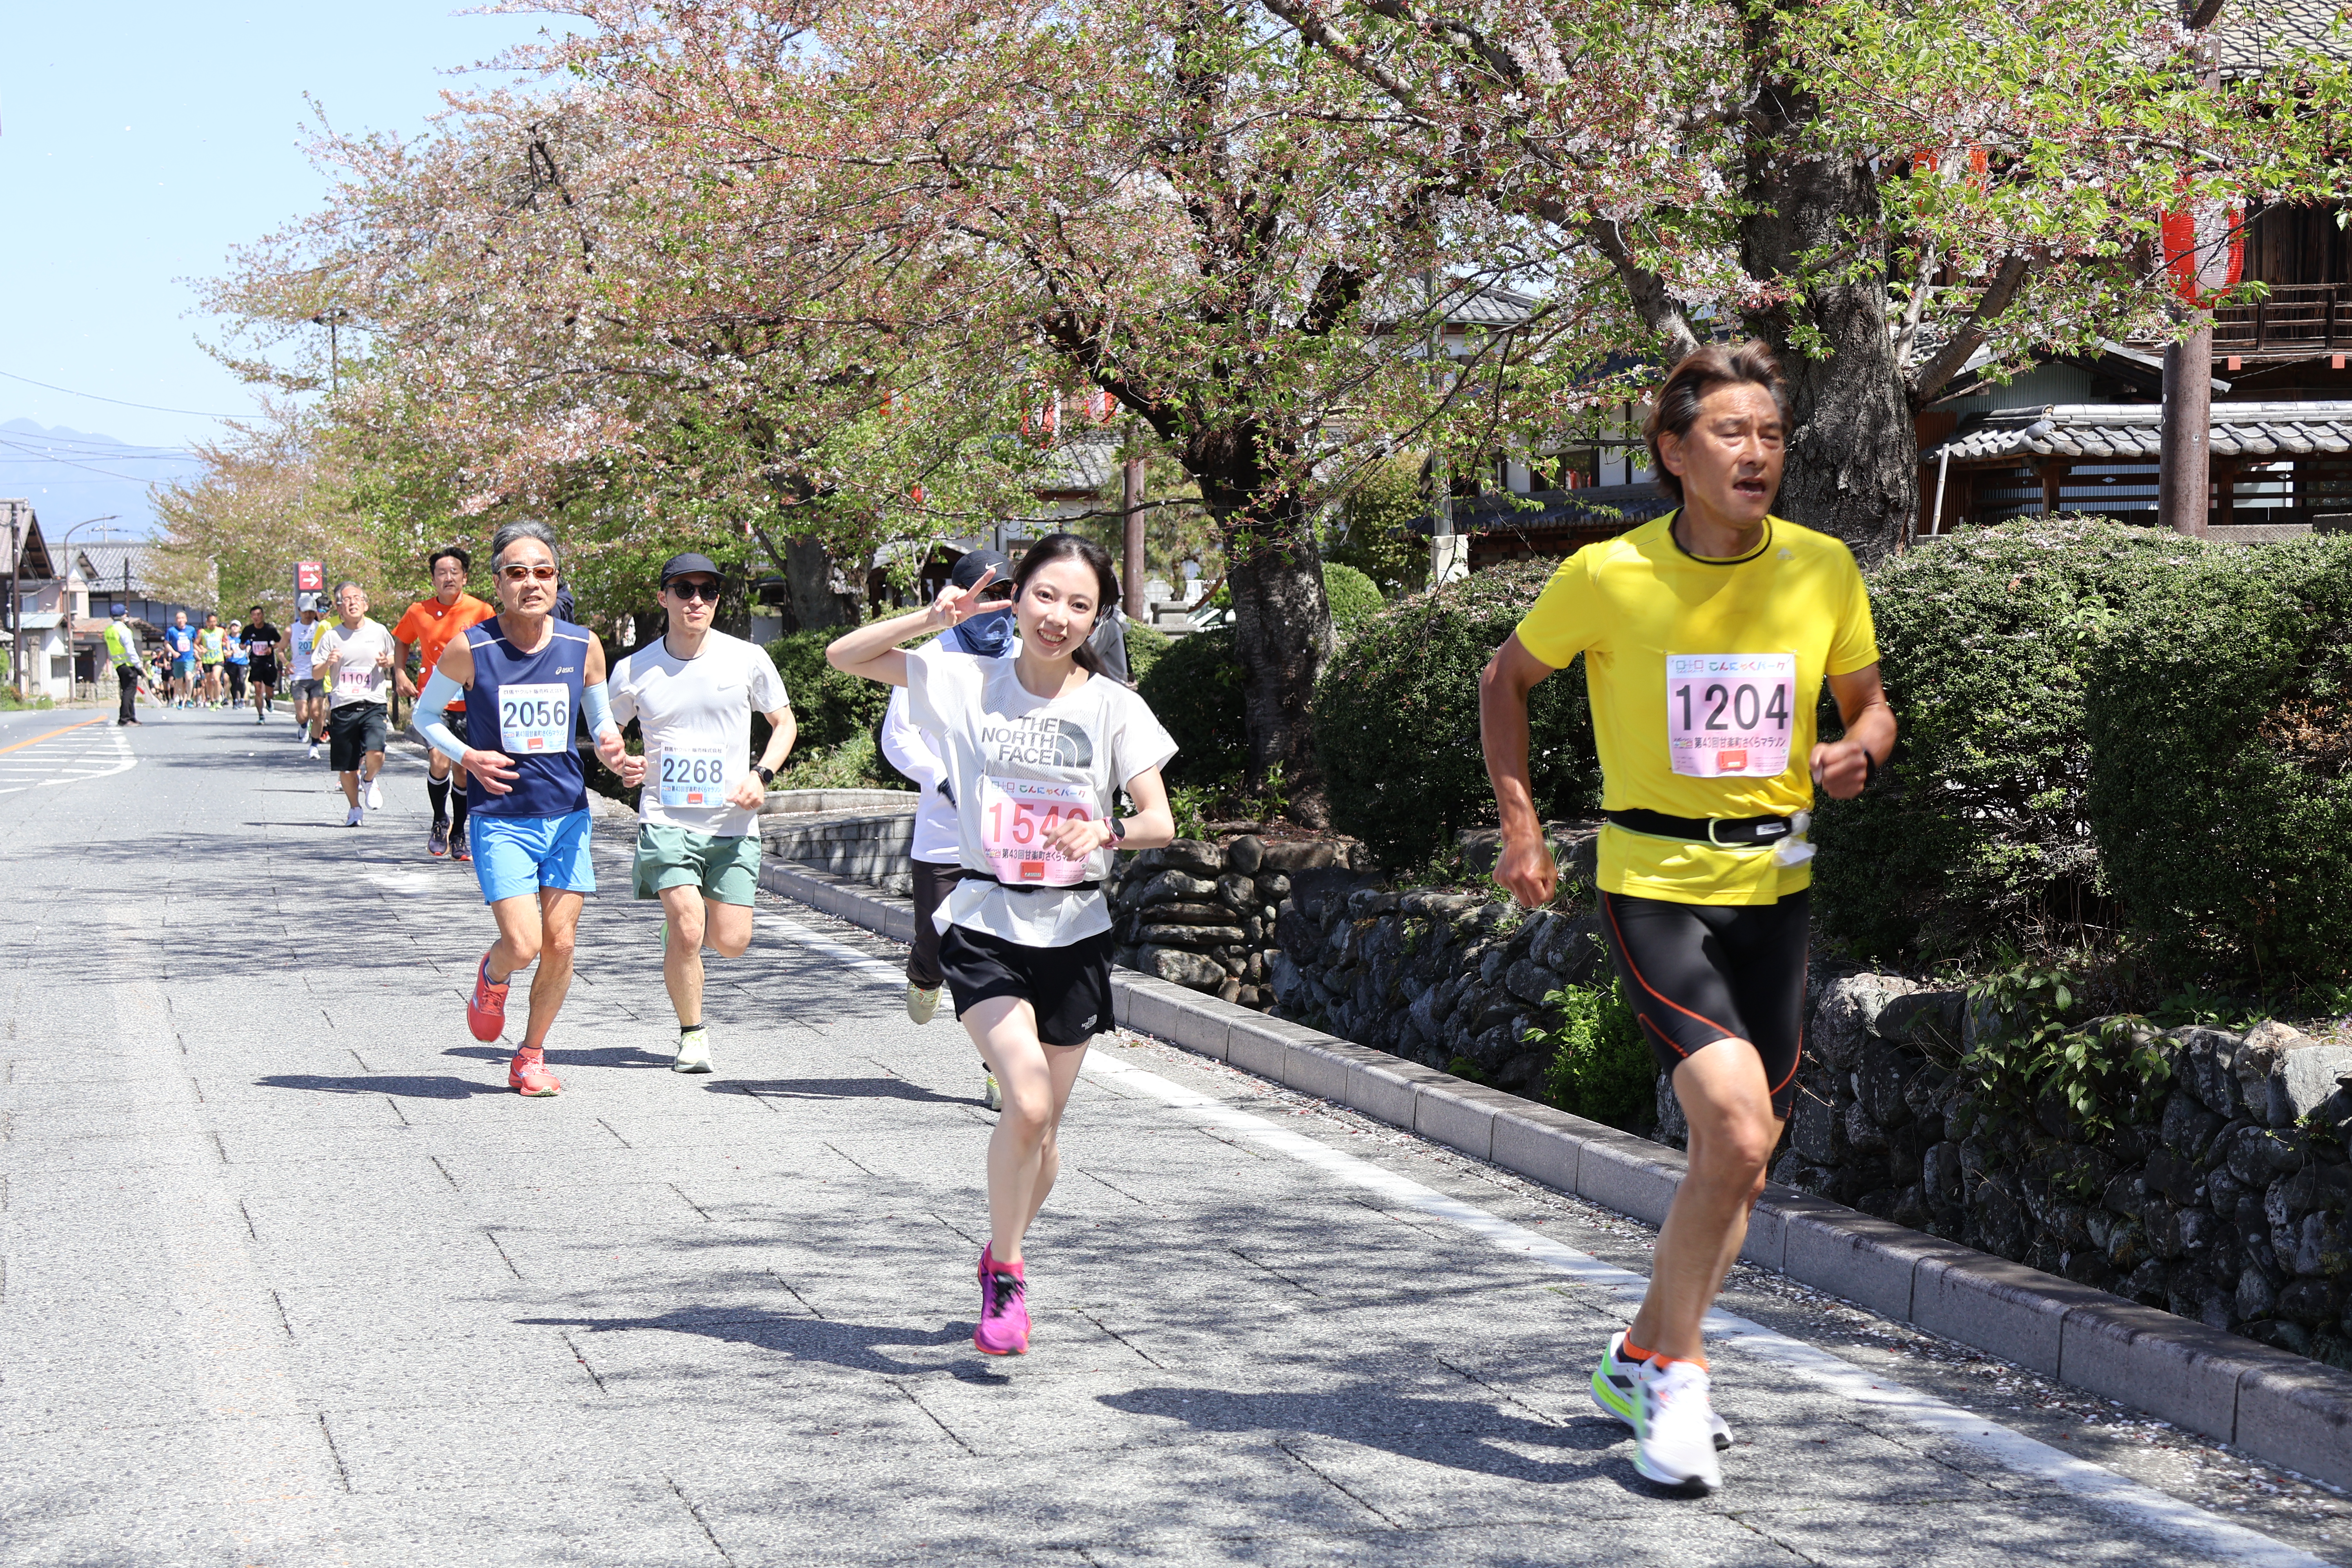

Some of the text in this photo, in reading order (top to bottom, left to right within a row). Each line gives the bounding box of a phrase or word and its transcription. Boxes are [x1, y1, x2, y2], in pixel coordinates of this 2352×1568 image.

[1709, 661, 1786, 671] こんにゃくパーク
[341, 673, 370, 685] 1104
[503, 700, 566, 728] 2056
[1676, 683, 1788, 730] 1204
[1018, 715, 1058, 733] THE
[981, 727, 1055, 748] NORTH
[999, 744, 1053, 766] FACE
[662, 758, 723, 783] 2268
[1019, 785, 1086, 798] こんにゃくパーク
